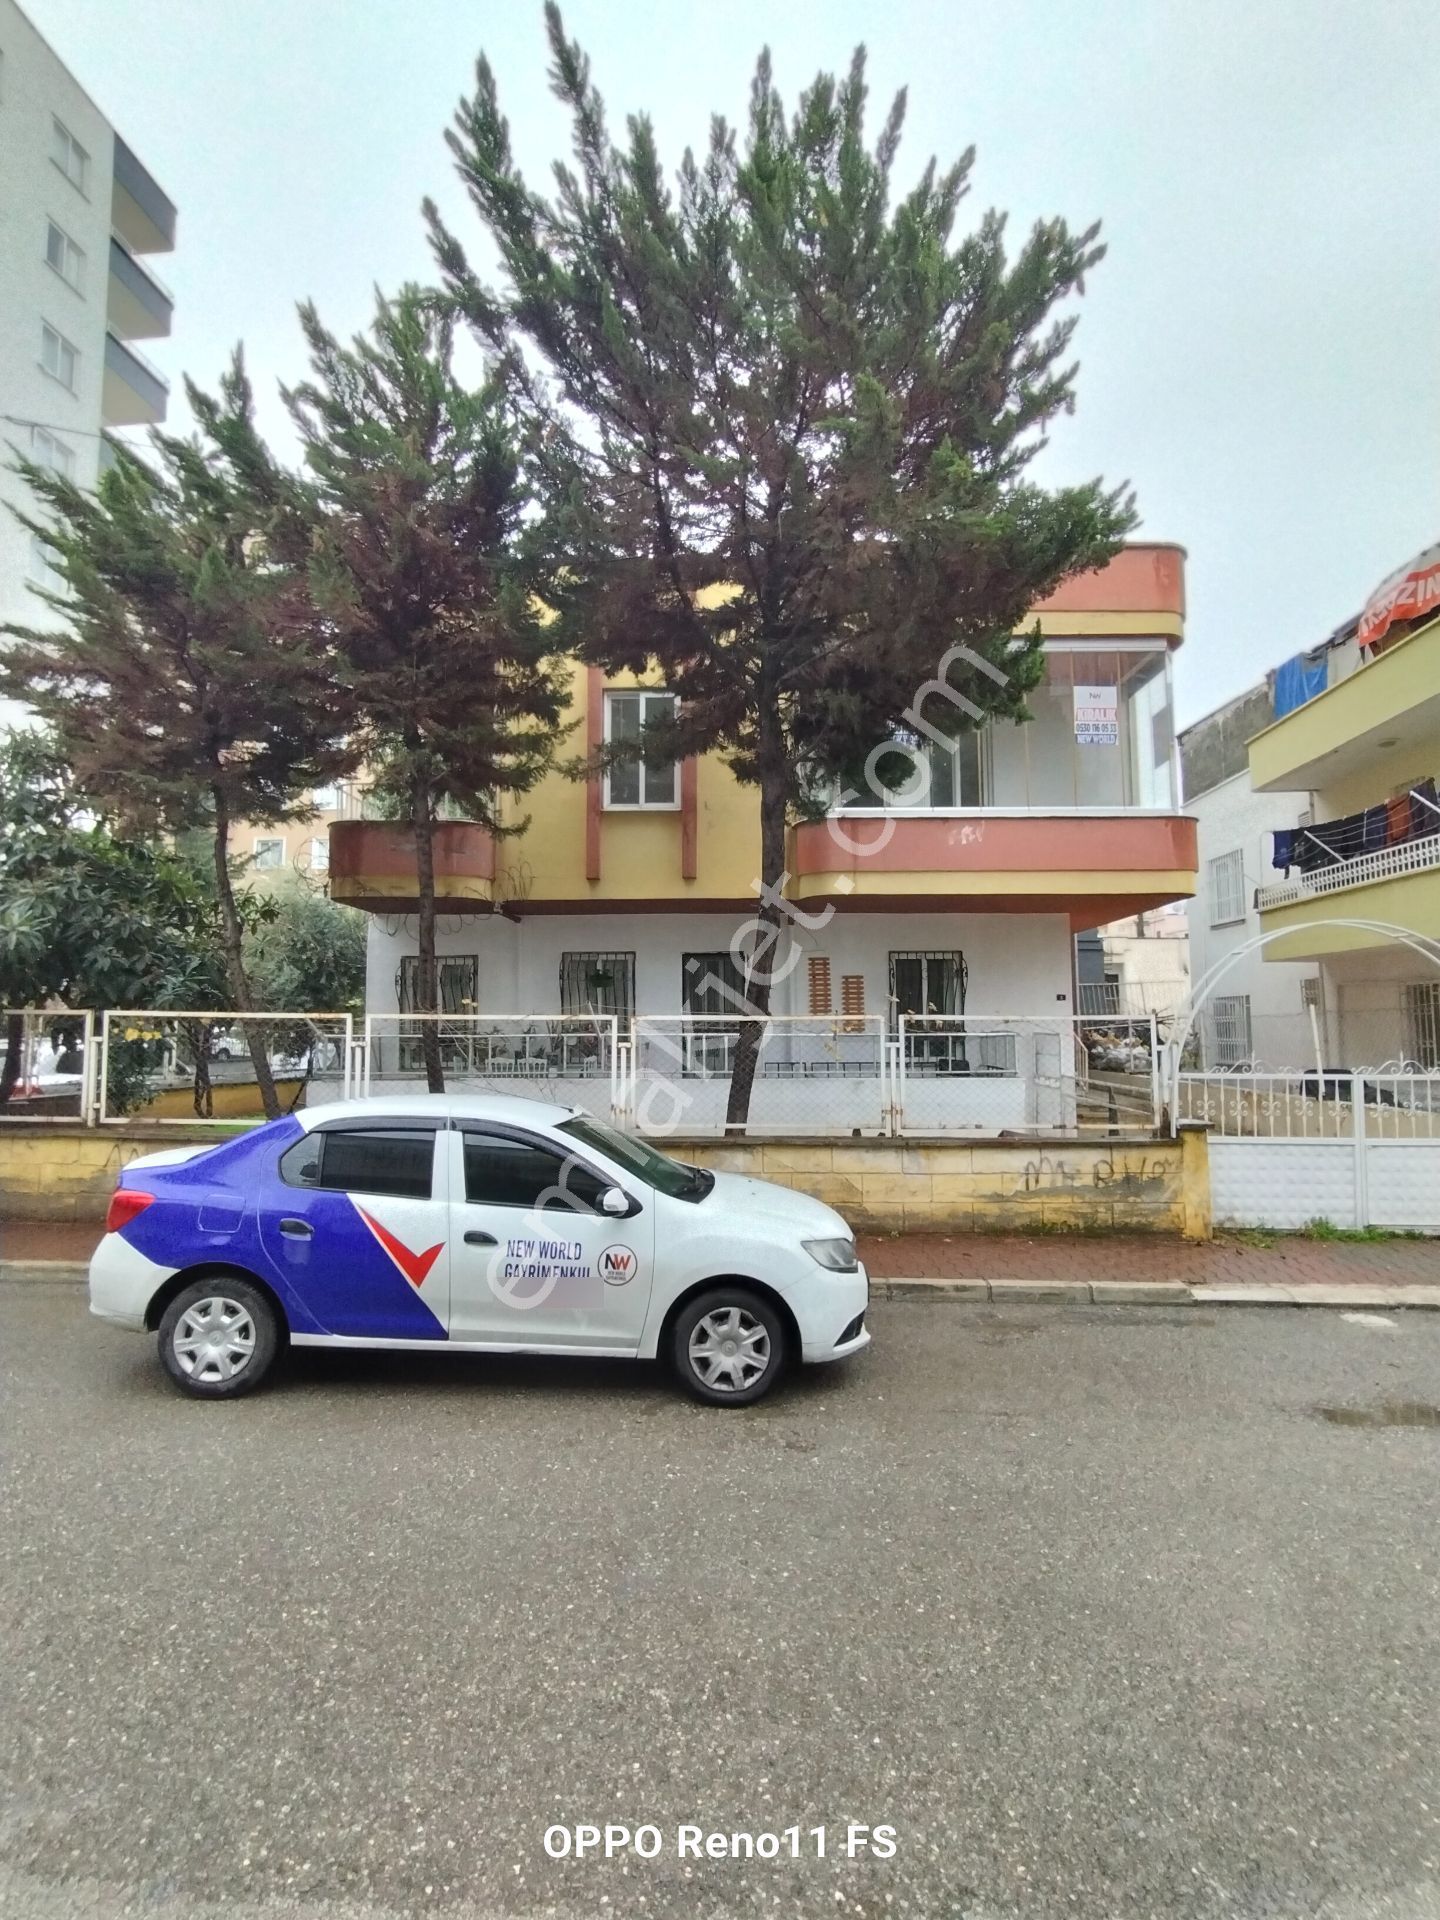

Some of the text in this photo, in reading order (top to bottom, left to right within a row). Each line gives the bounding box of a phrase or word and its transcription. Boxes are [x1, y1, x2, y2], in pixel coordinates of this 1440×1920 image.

[506, 1239, 582, 1260] NEW WORLD
[604, 1253, 631, 1271] NW
